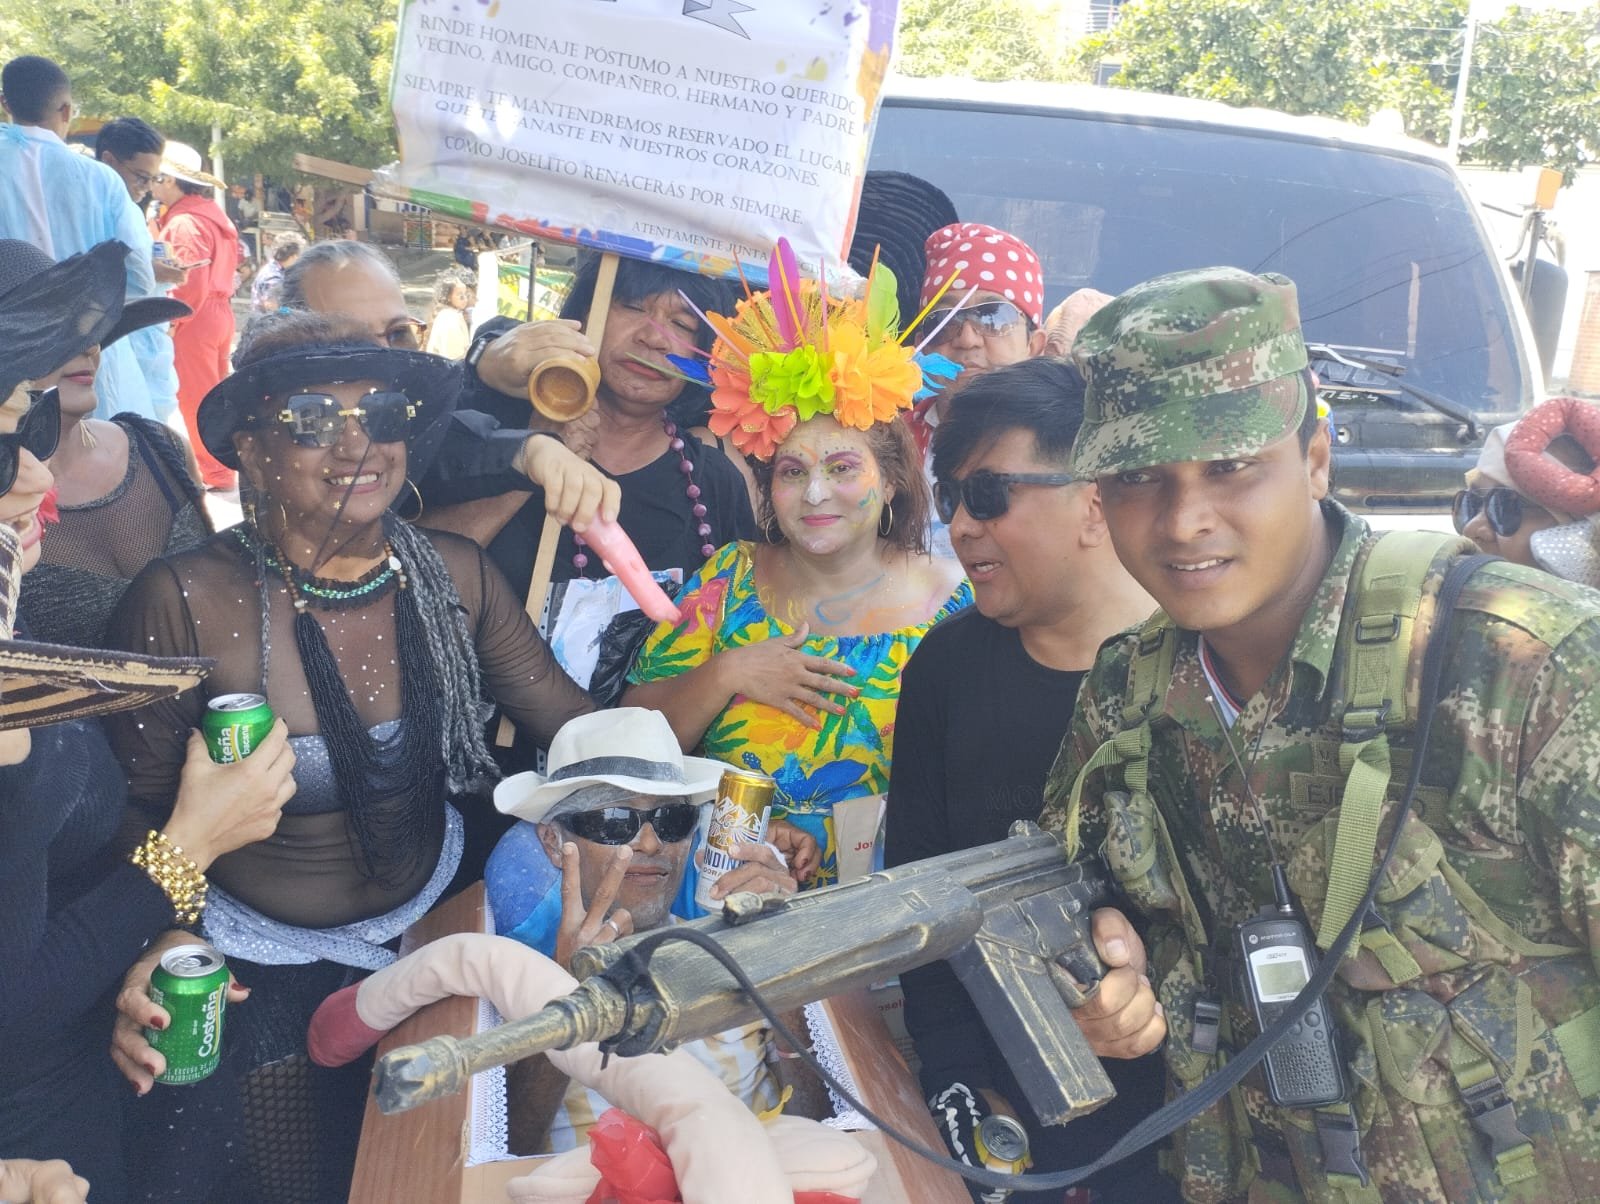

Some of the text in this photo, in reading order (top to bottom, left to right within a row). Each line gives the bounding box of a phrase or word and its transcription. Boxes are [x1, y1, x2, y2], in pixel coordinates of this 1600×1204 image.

[415, 33, 857, 137] VECINO, AMIGO, COMPAÑERO, HERMANO Y PADRE
[419, 13, 475, 38] RINDE
[479, 25, 579, 58] HOMENAJE
[675, 65, 688, 80] A
[695, 66, 776, 97] NUESTRO
[780, 84, 857, 116] QUERIDO
[509, 115, 585, 141] ANASTE
[591, 129, 614, 146] EN
[618, 134, 708, 163] NUESTROS
[712, 151, 821, 188] CORAZONES.
[511, 94, 662, 136] MANTENDREMOS
[667, 124, 769, 157] RESERVADO
[774, 142, 793, 160] EL
[799, 148, 851, 178] LUGAR
[443, 135, 805, 226] COMO JOSELITO RENACERÁS POR SIEMPRE.
[631, 220, 769, 263] ATENTAMENTE JUNTA
[217, 727, 233, 765] teña
[703, 846, 746, 871] NDIN
[198, 990, 219, 1058] Costeña
